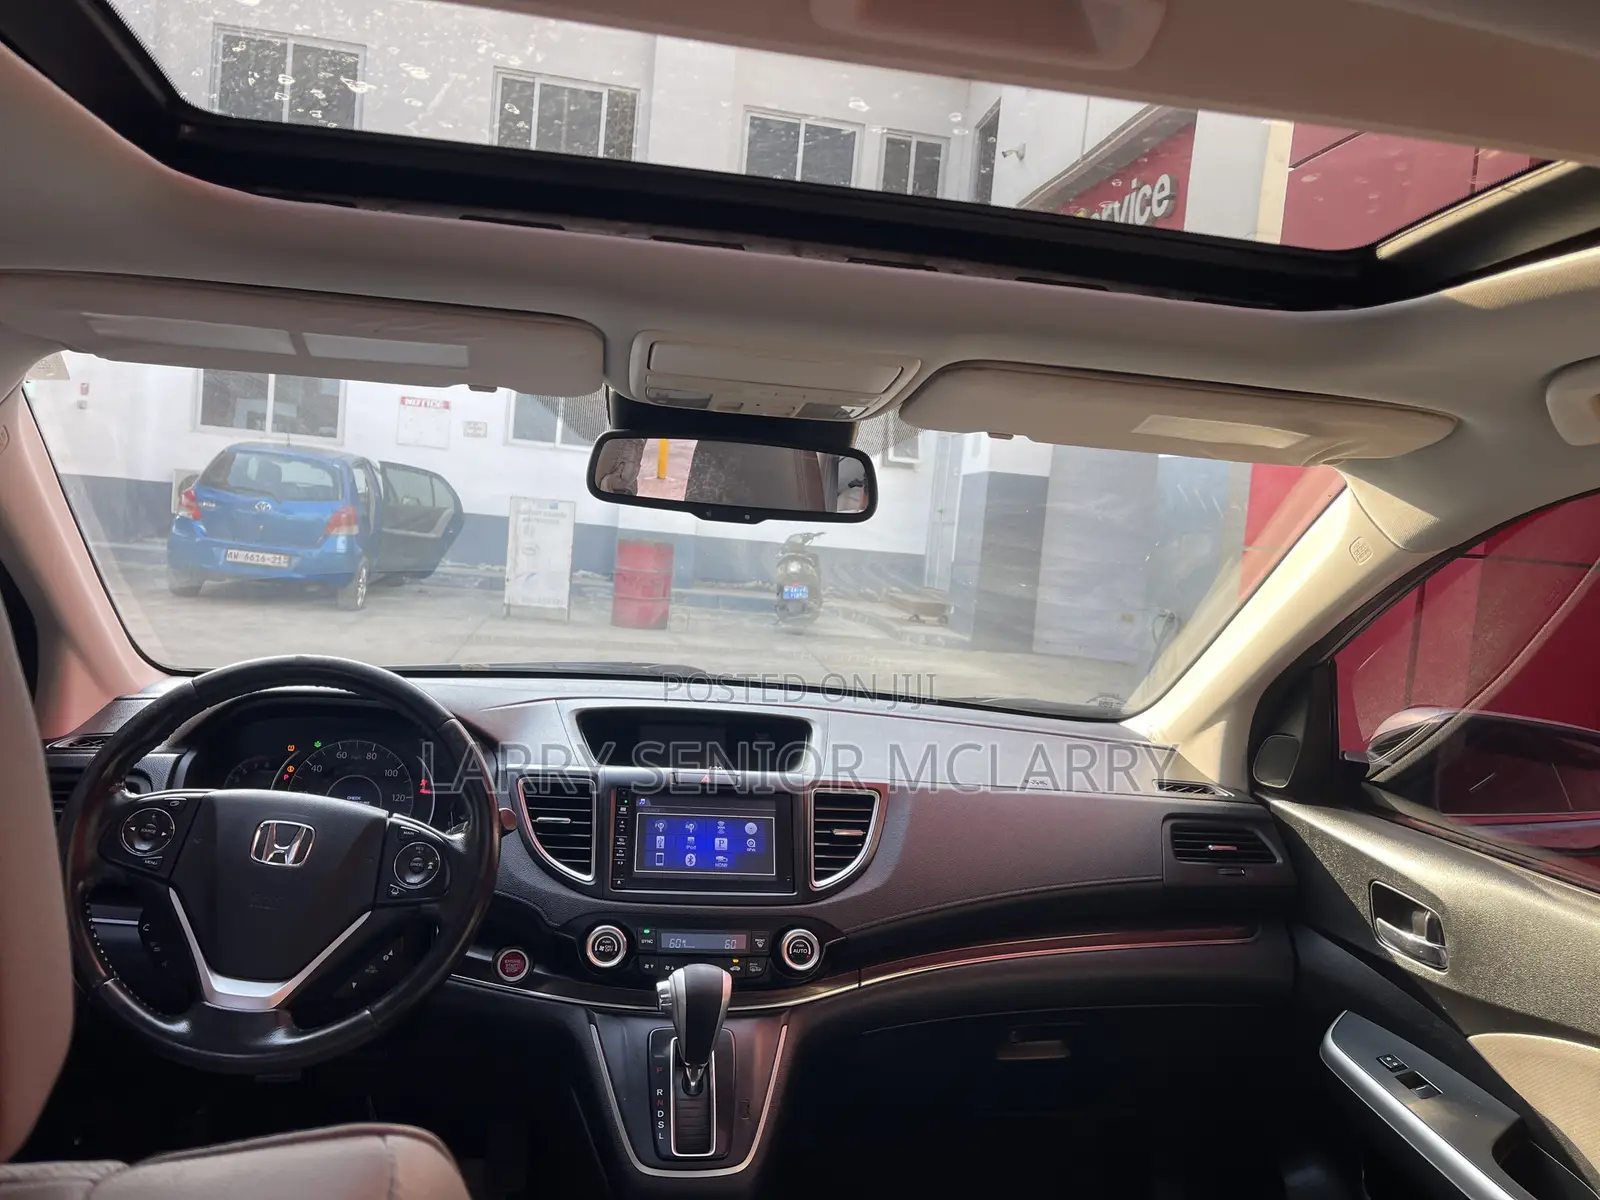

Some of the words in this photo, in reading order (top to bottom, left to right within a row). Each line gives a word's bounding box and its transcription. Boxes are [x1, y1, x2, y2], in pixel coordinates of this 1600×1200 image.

[336, 751, 348, 760] 60
[366, 752, 378, 761] 80
[311, 764, 323, 773] 40
[384, 769, 399, 777] 100
[392, 793, 405, 802] 120
[792, 947, 808, 955] AUTO
[657, 1110, 665, 1118] D
[657, 1121, 665, 1129] S
[658, 1132, 664, 1140] L
